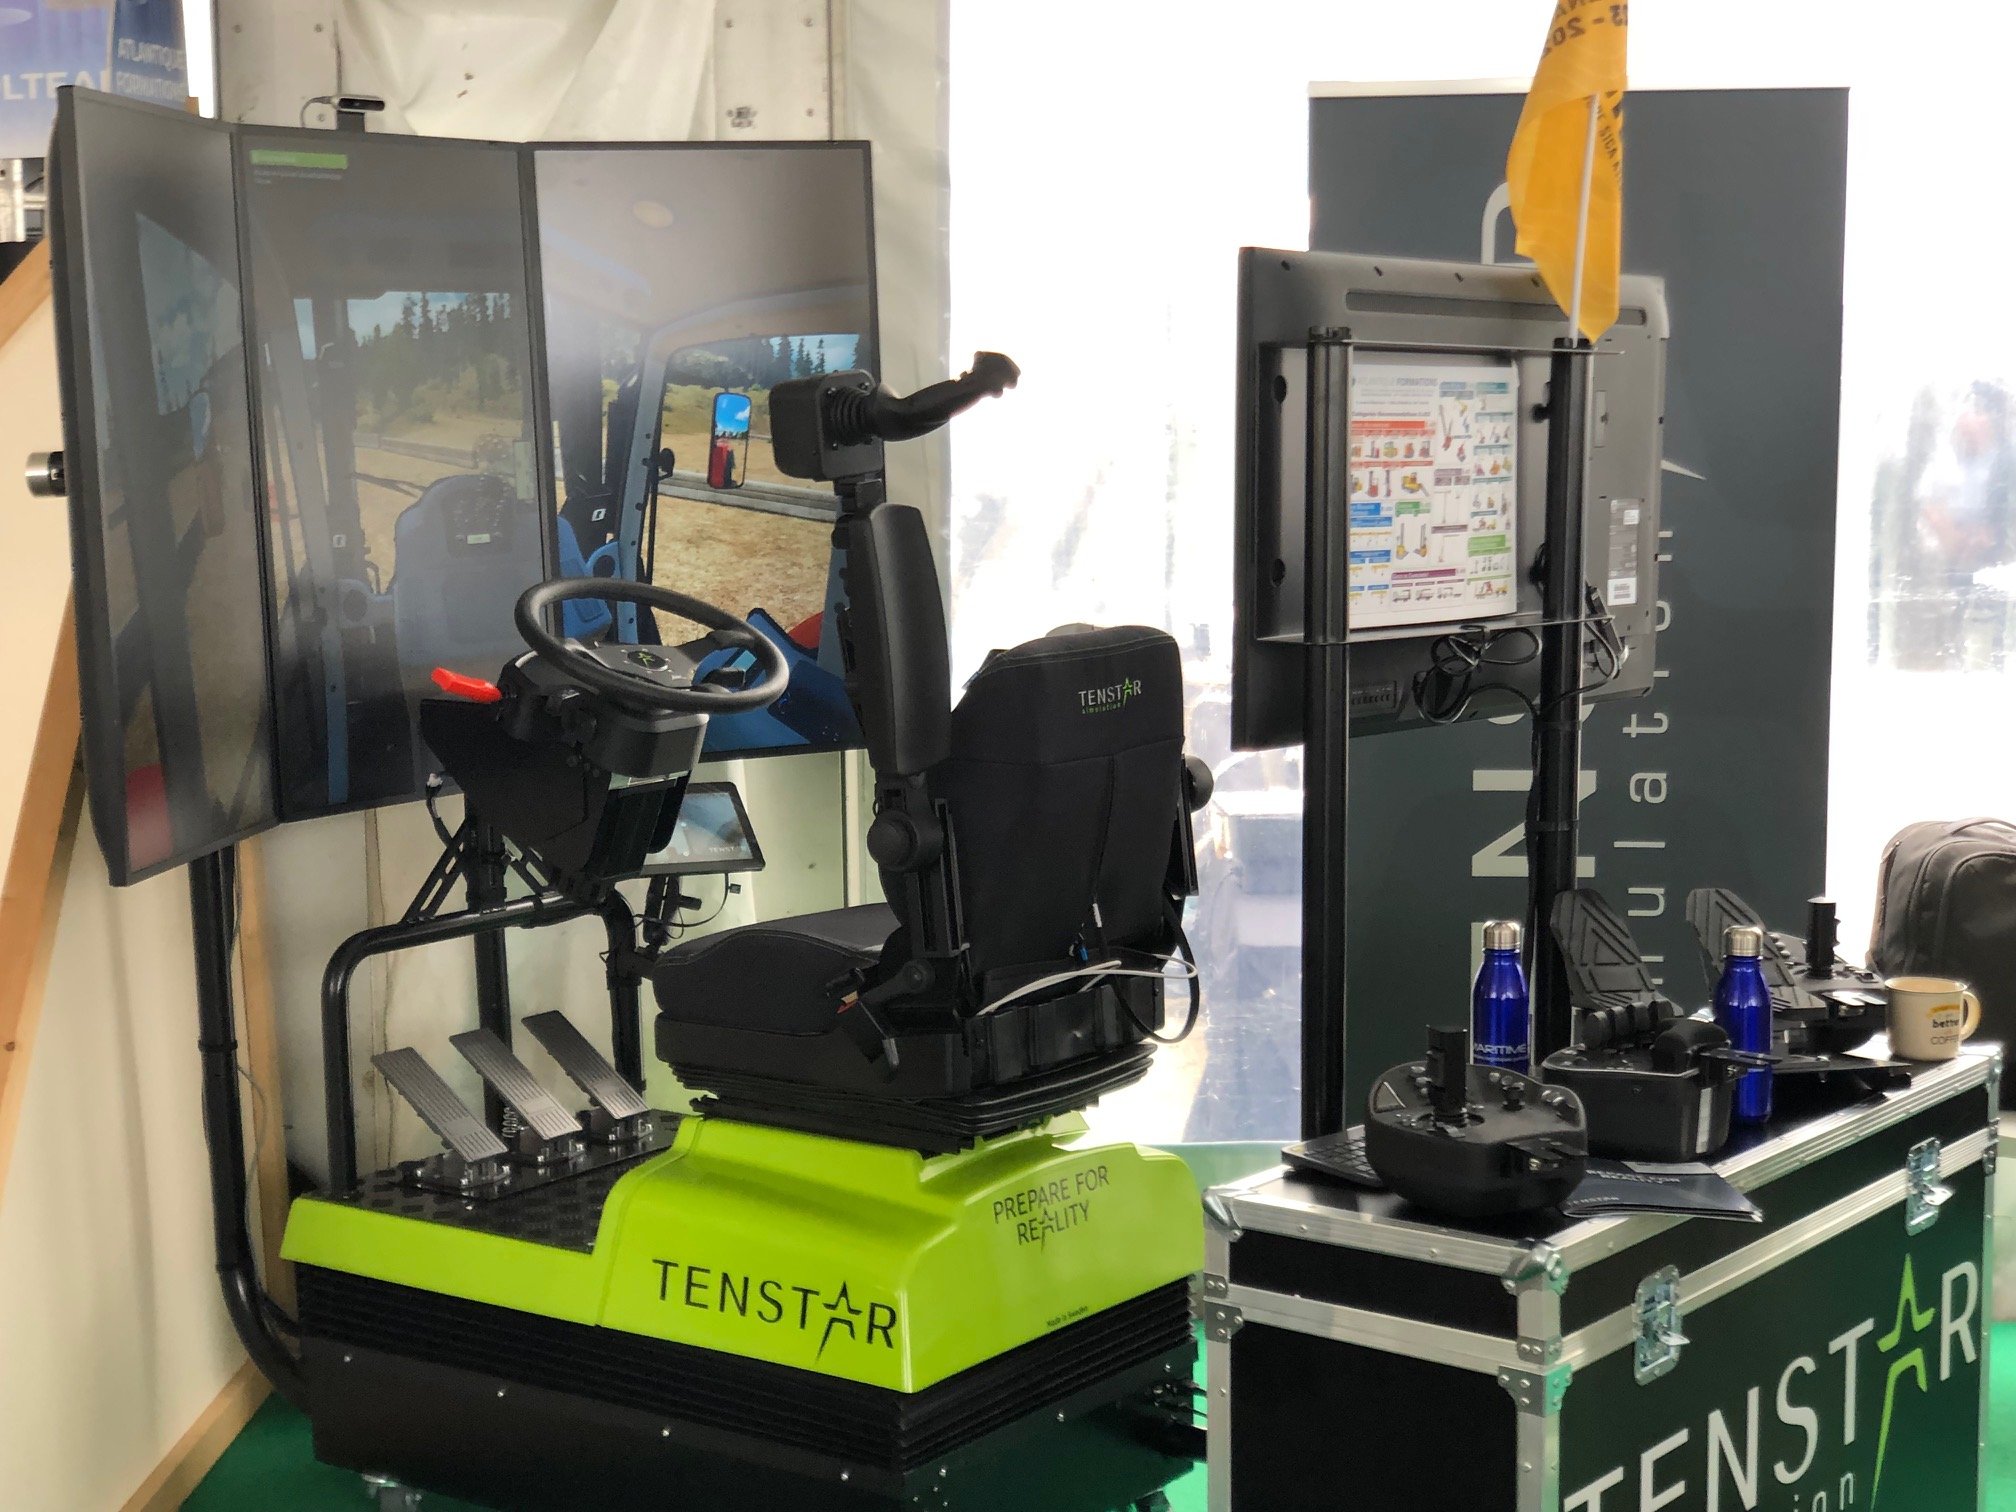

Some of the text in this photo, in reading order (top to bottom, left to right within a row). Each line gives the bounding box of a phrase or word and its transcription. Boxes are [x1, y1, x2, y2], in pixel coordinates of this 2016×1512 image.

[1078, 677, 1142, 708] TENSTAR
[993, 1165, 1110, 1224] PREPARE FOR
[1016, 1199, 1090, 1256] REALITY
[652, 1258, 898, 1366] TENSTAR
